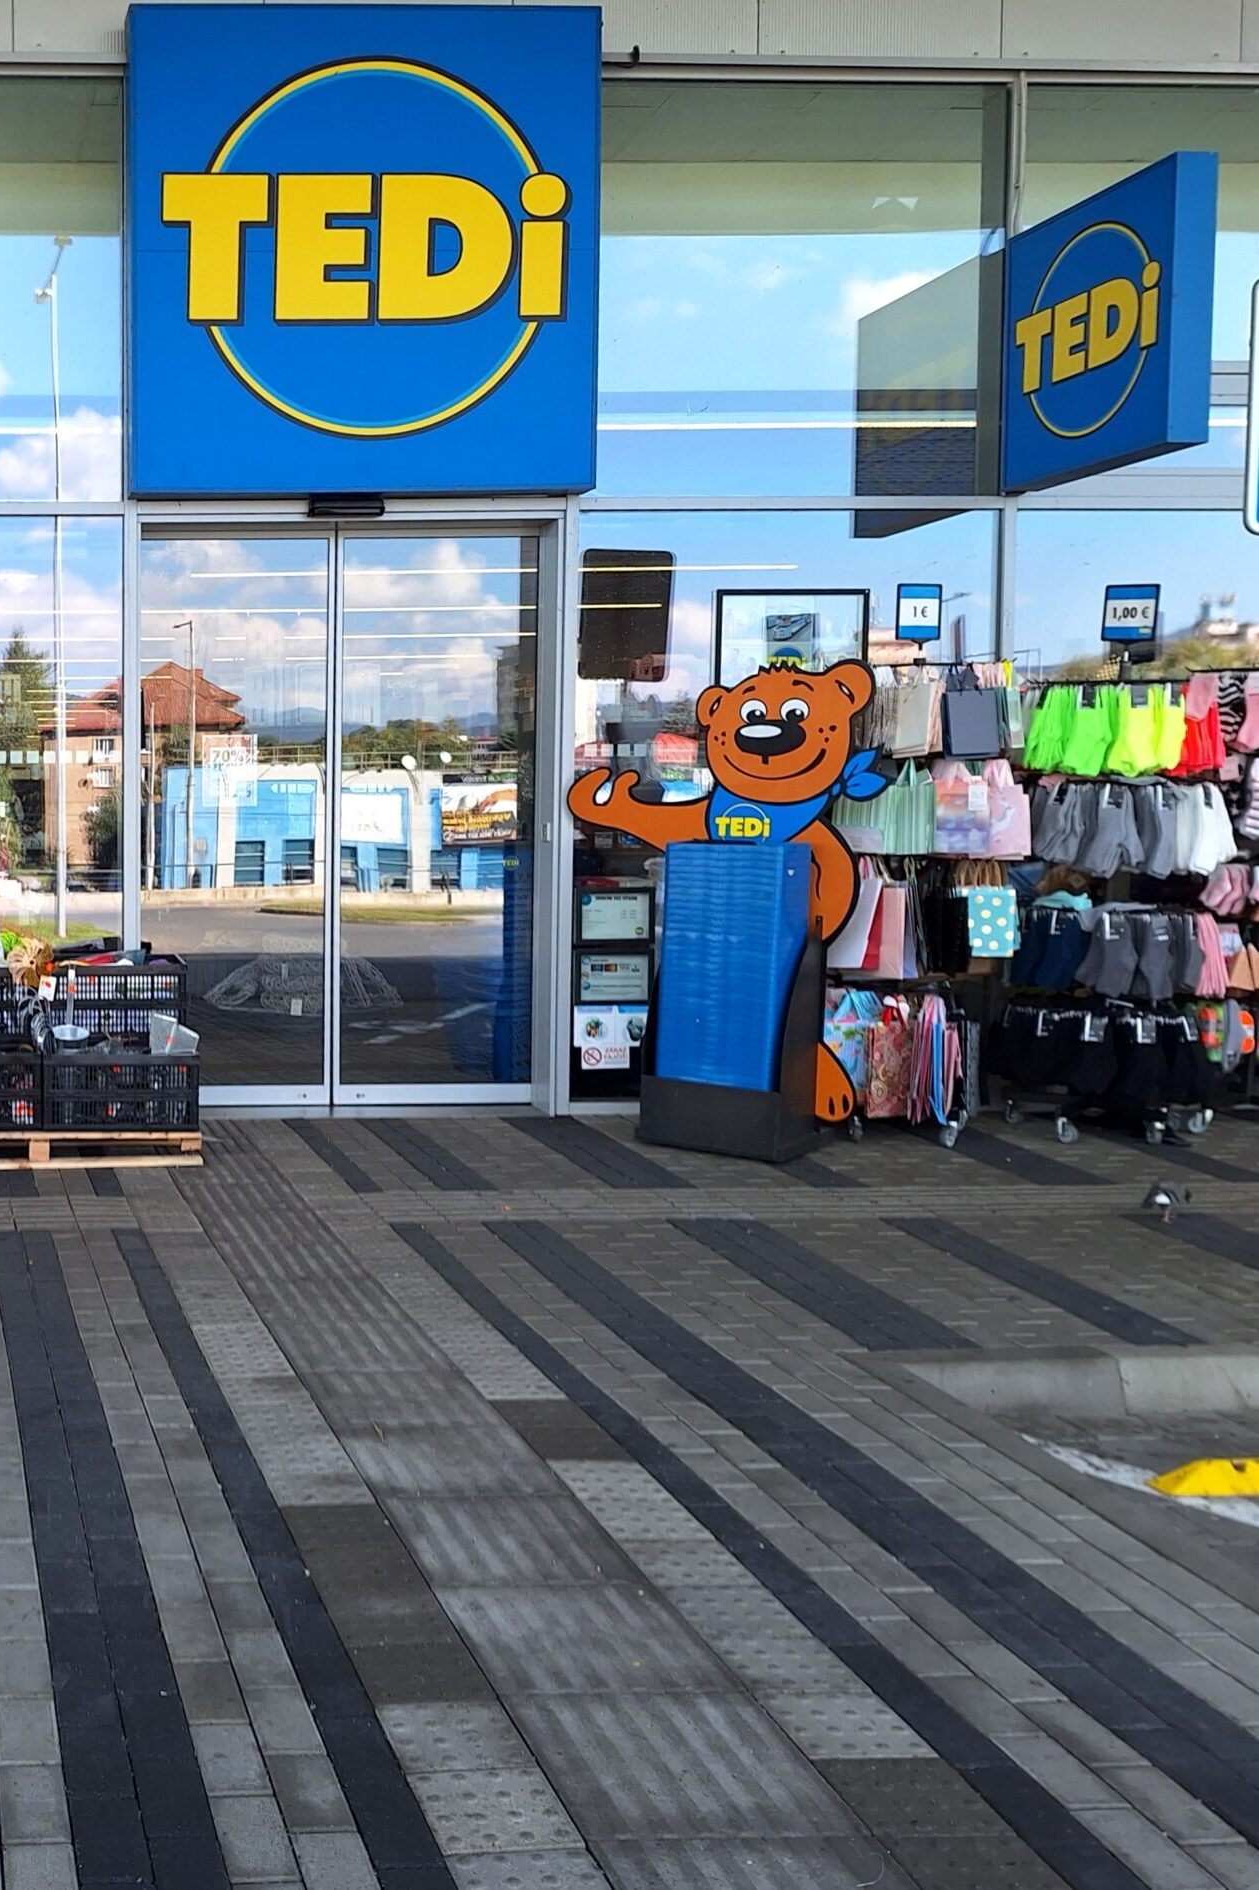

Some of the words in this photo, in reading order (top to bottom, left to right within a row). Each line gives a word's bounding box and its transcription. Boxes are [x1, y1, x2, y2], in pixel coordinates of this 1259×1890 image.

[162, 172, 571, 325] TEDi
[1015, 260, 1161, 394] TEDi
[715, 816, 770, 838] TEDi
